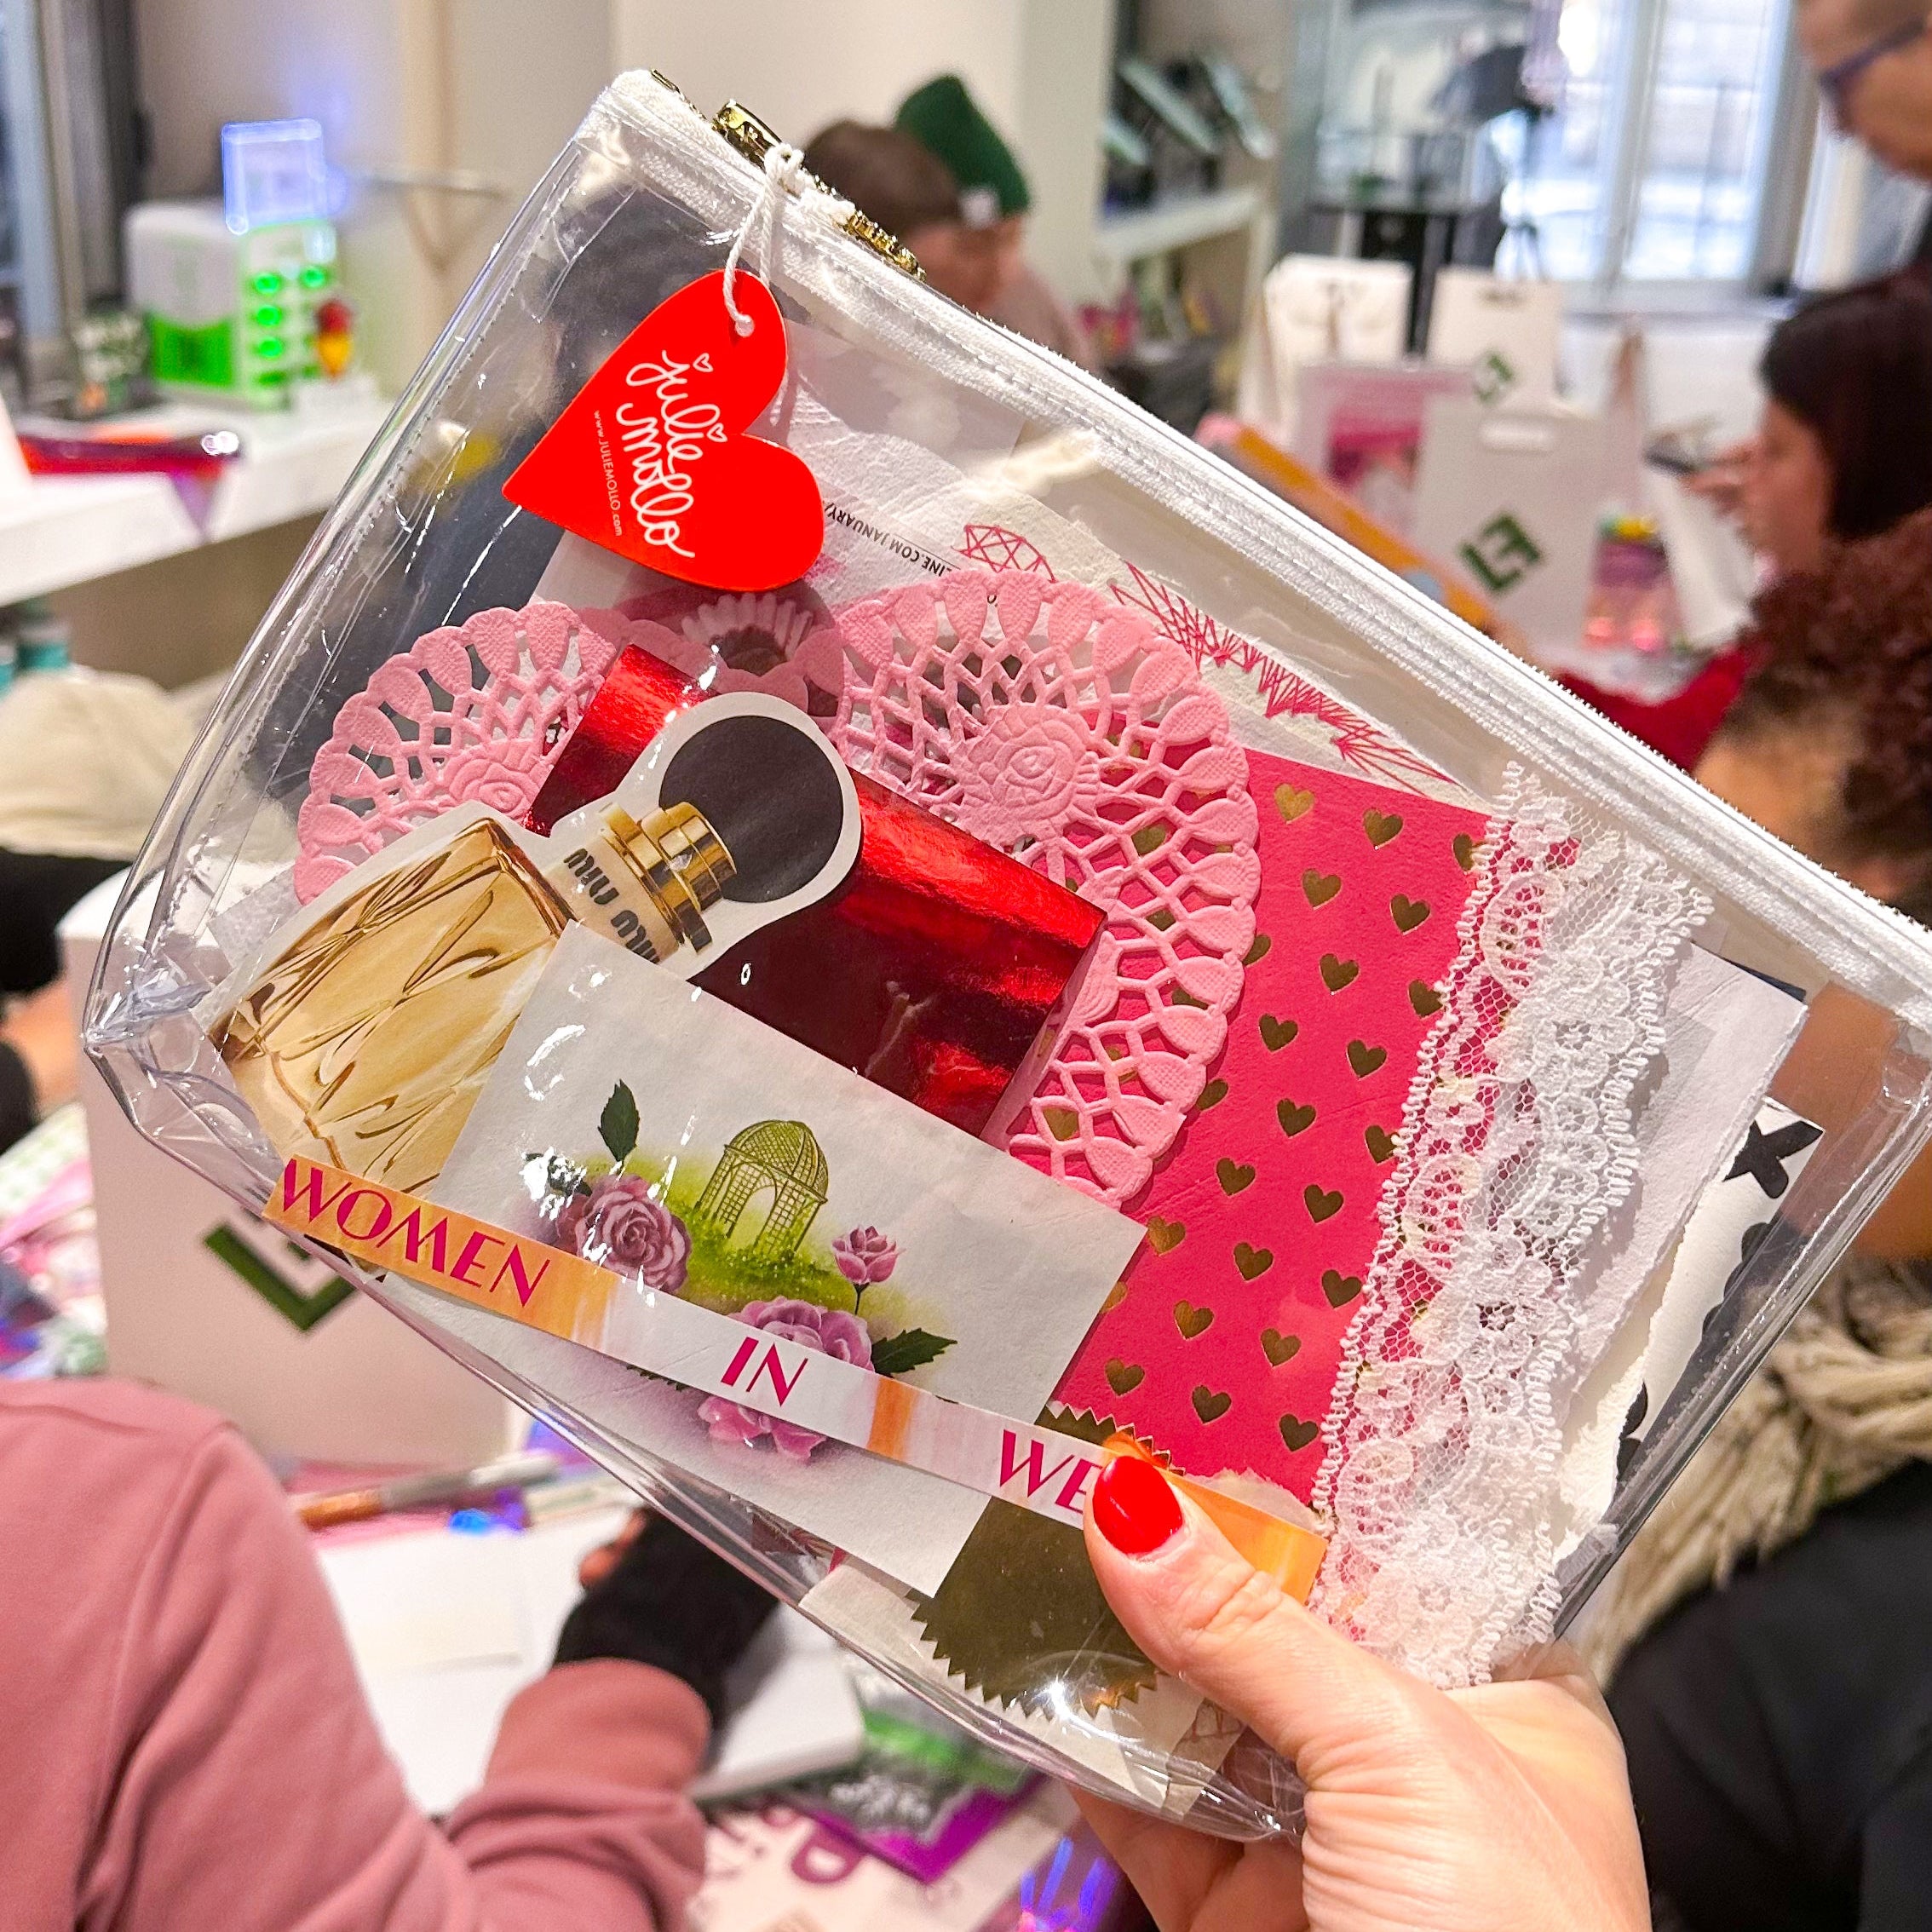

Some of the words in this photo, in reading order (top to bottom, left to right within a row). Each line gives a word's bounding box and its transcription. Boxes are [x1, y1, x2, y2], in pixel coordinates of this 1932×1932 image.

[593, 410, 623, 537] www.JULIEMOLLO.com
[888, 538, 953, 578] INE.COM
[282, 1158, 550, 1308] WOMEN
[720, 1336, 808, 1406] IN
